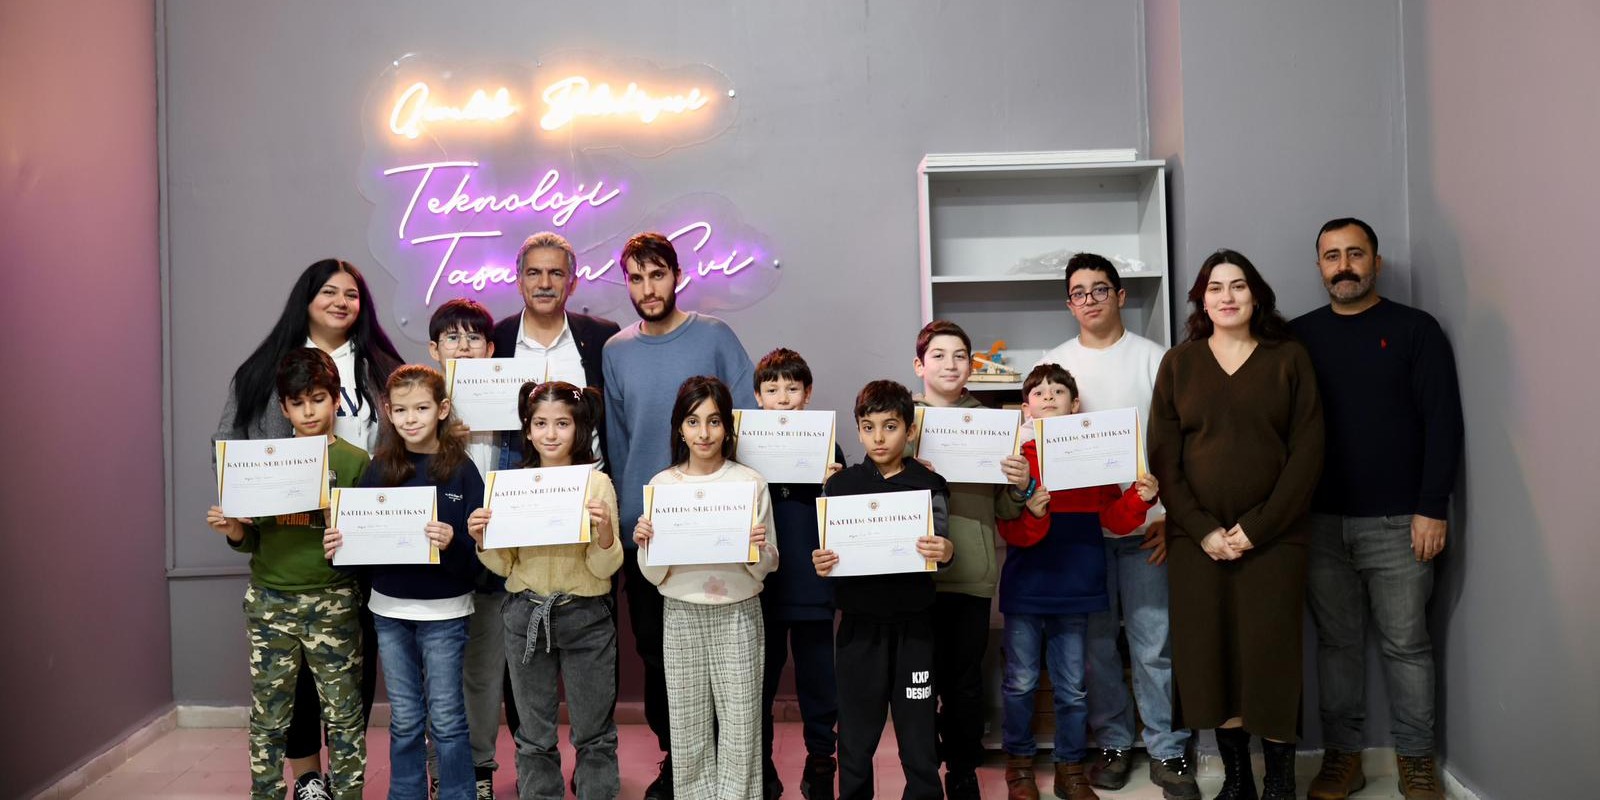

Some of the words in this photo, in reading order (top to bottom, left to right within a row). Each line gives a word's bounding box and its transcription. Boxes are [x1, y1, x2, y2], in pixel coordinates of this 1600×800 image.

[384, 161, 621, 239] Teknoloji
[1046, 435, 1079, 444] KATILIM
[227, 461, 261, 469] KATILIM
[494, 489, 528, 498] KATILIM
[655, 506, 691, 514] KATILIM
[829, 518, 866, 526] KATILIM
[912, 671, 929, 683] KXP
